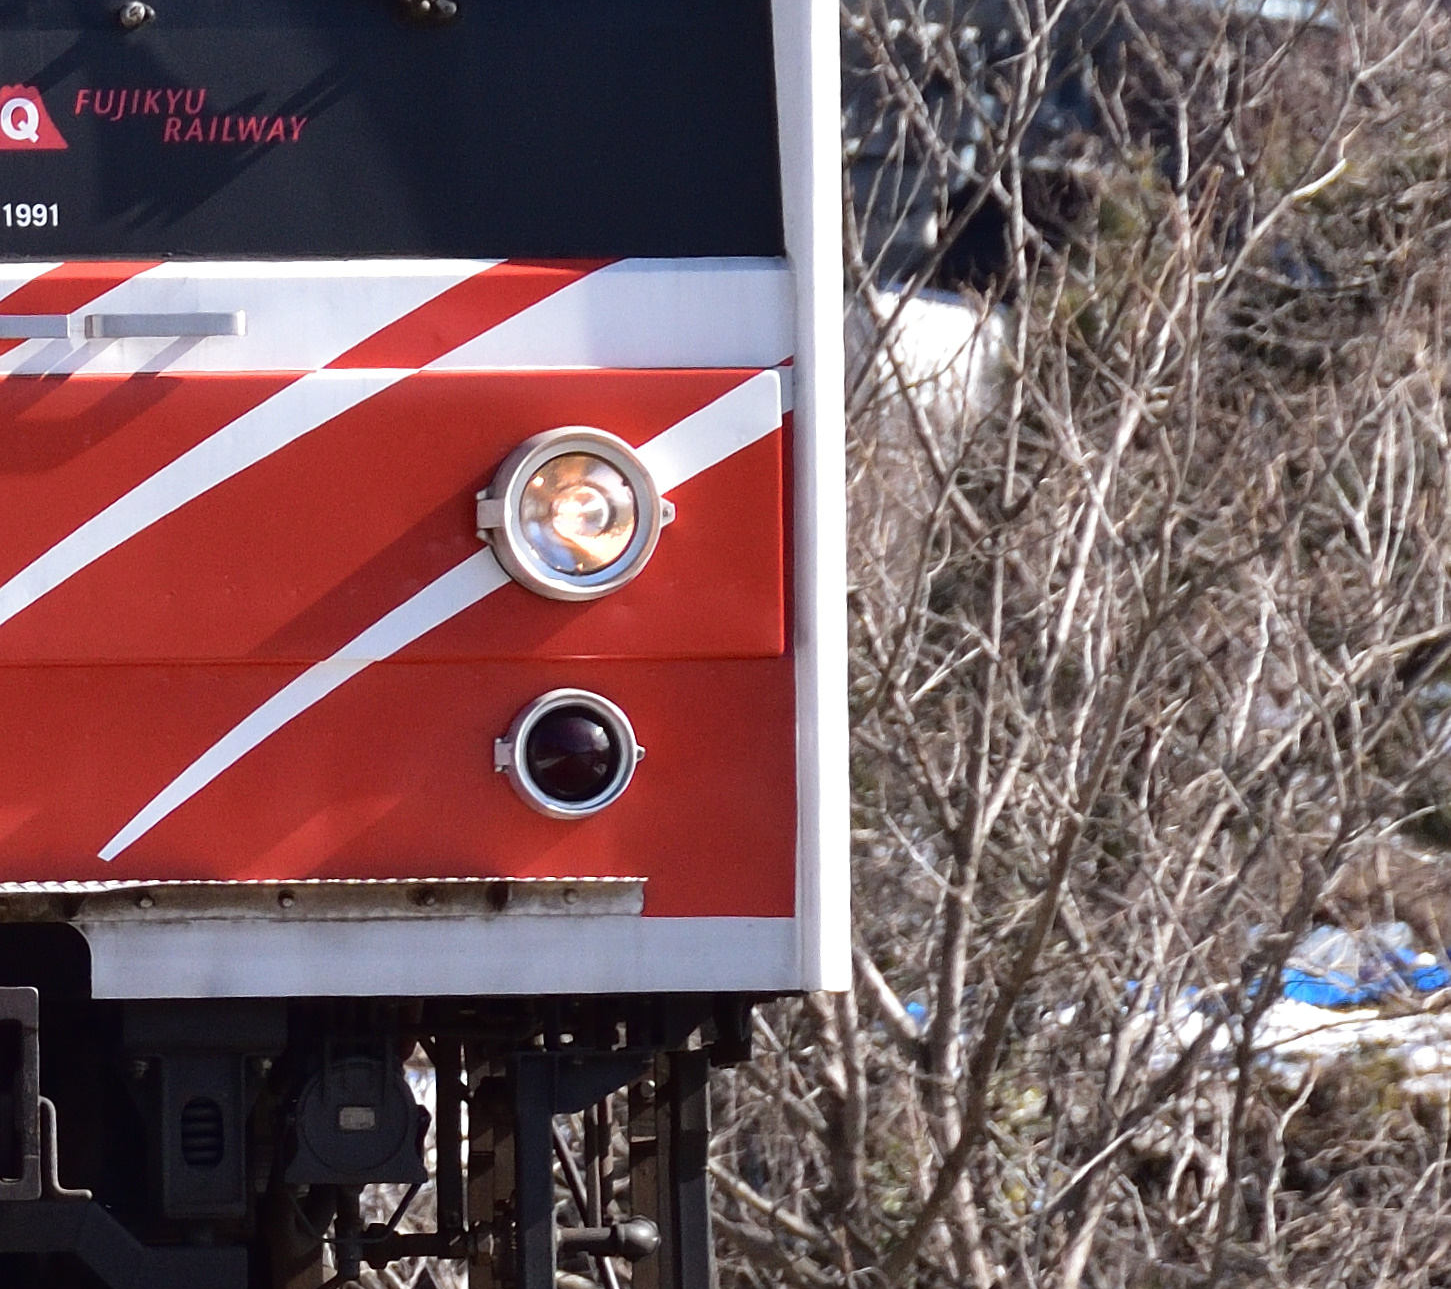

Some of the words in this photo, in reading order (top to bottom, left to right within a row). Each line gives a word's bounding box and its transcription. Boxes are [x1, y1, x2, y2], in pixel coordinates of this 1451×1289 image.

[75, 88, 206, 121] FUJIKYU
[0, 97, 40, 143] Q
[163, 116, 308, 142] RAILWAY
[2, 202, 60, 227] 1991
